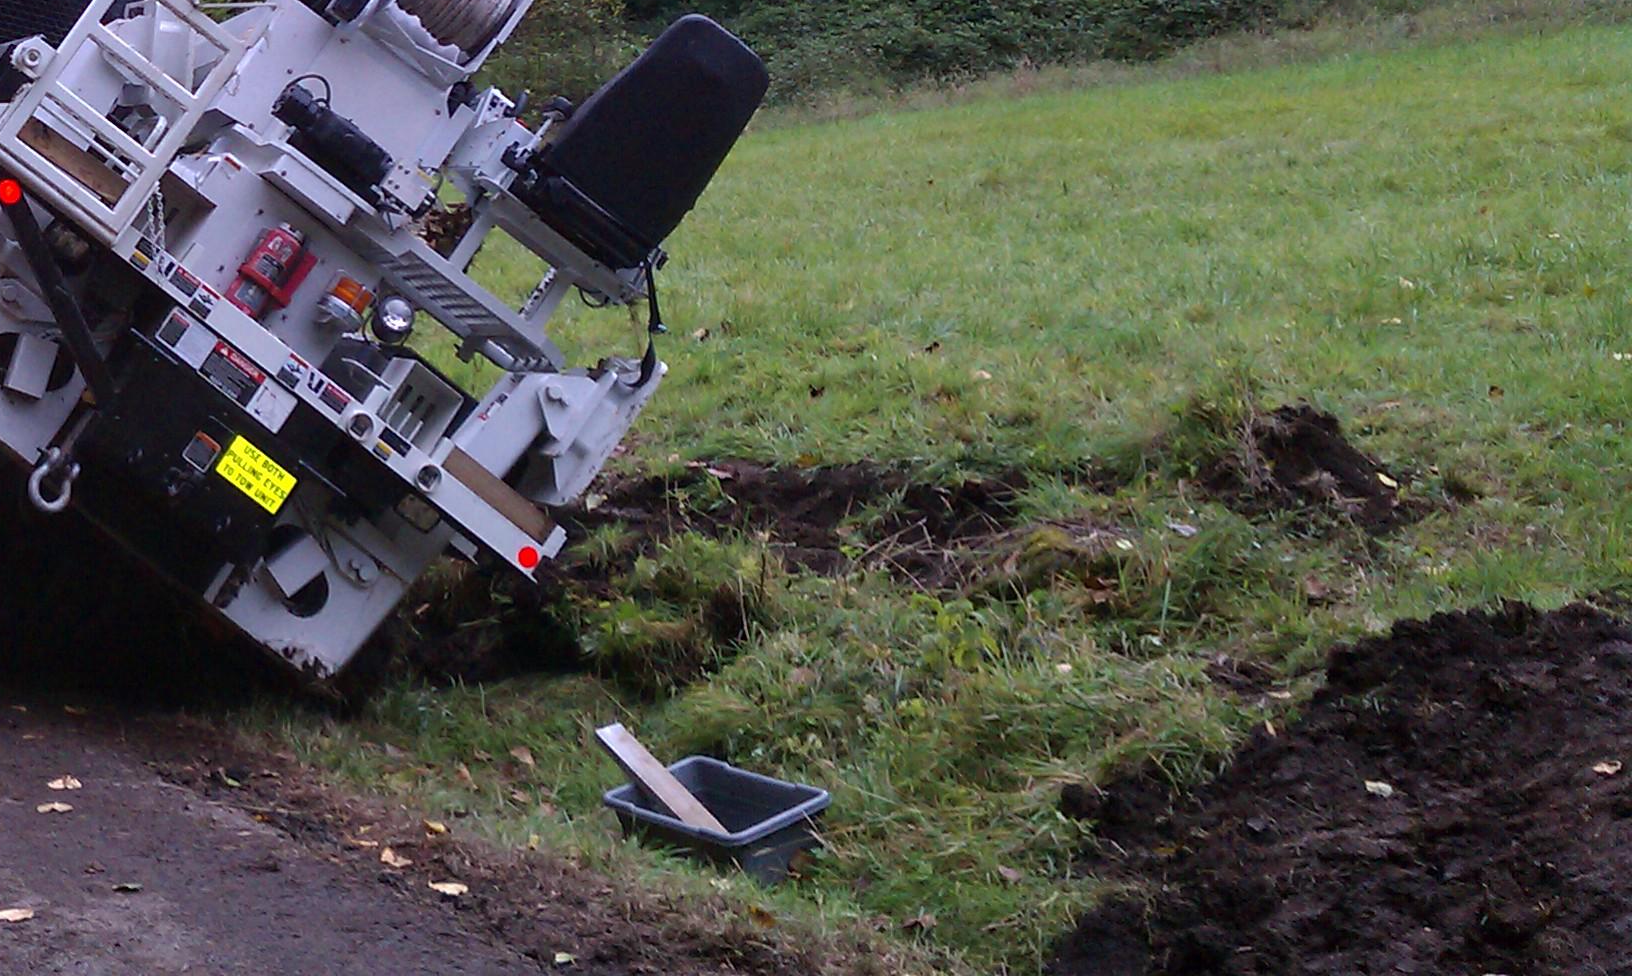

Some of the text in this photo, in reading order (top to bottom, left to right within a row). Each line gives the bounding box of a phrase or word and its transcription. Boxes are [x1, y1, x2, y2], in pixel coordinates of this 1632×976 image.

[222, 463, 277, 509] TO TOW UNIT
[228, 450, 263, 482] PULLING
[262, 477, 288, 501] EYES
[242, 444, 262, 464] USE
[261, 459, 286, 482] BOTH
